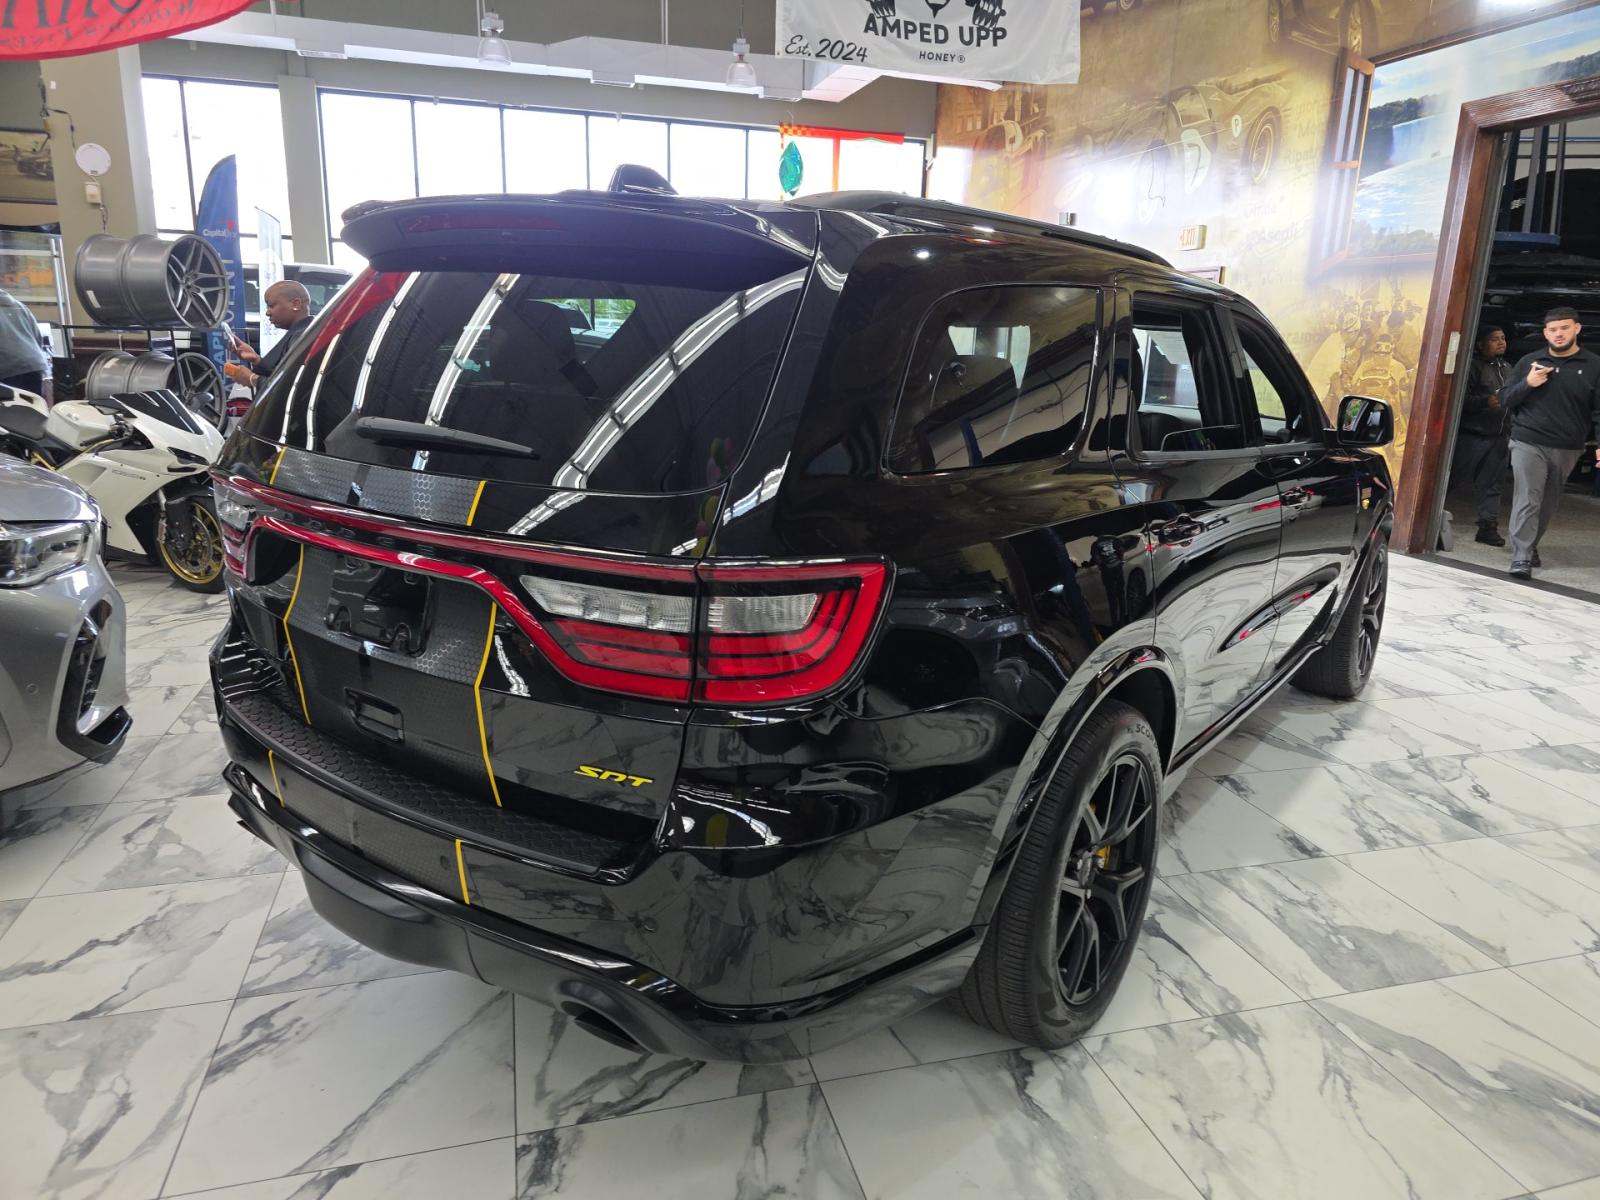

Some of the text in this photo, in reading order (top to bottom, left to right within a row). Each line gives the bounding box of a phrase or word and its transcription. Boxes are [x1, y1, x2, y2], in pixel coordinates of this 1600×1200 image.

[863, 13, 1008, 48] AMPED UPP
[784, 34, 868, 62] Est. 2024
[918, 50, 956, 63] HONEY
[573, 764, 654, 787] SRT
